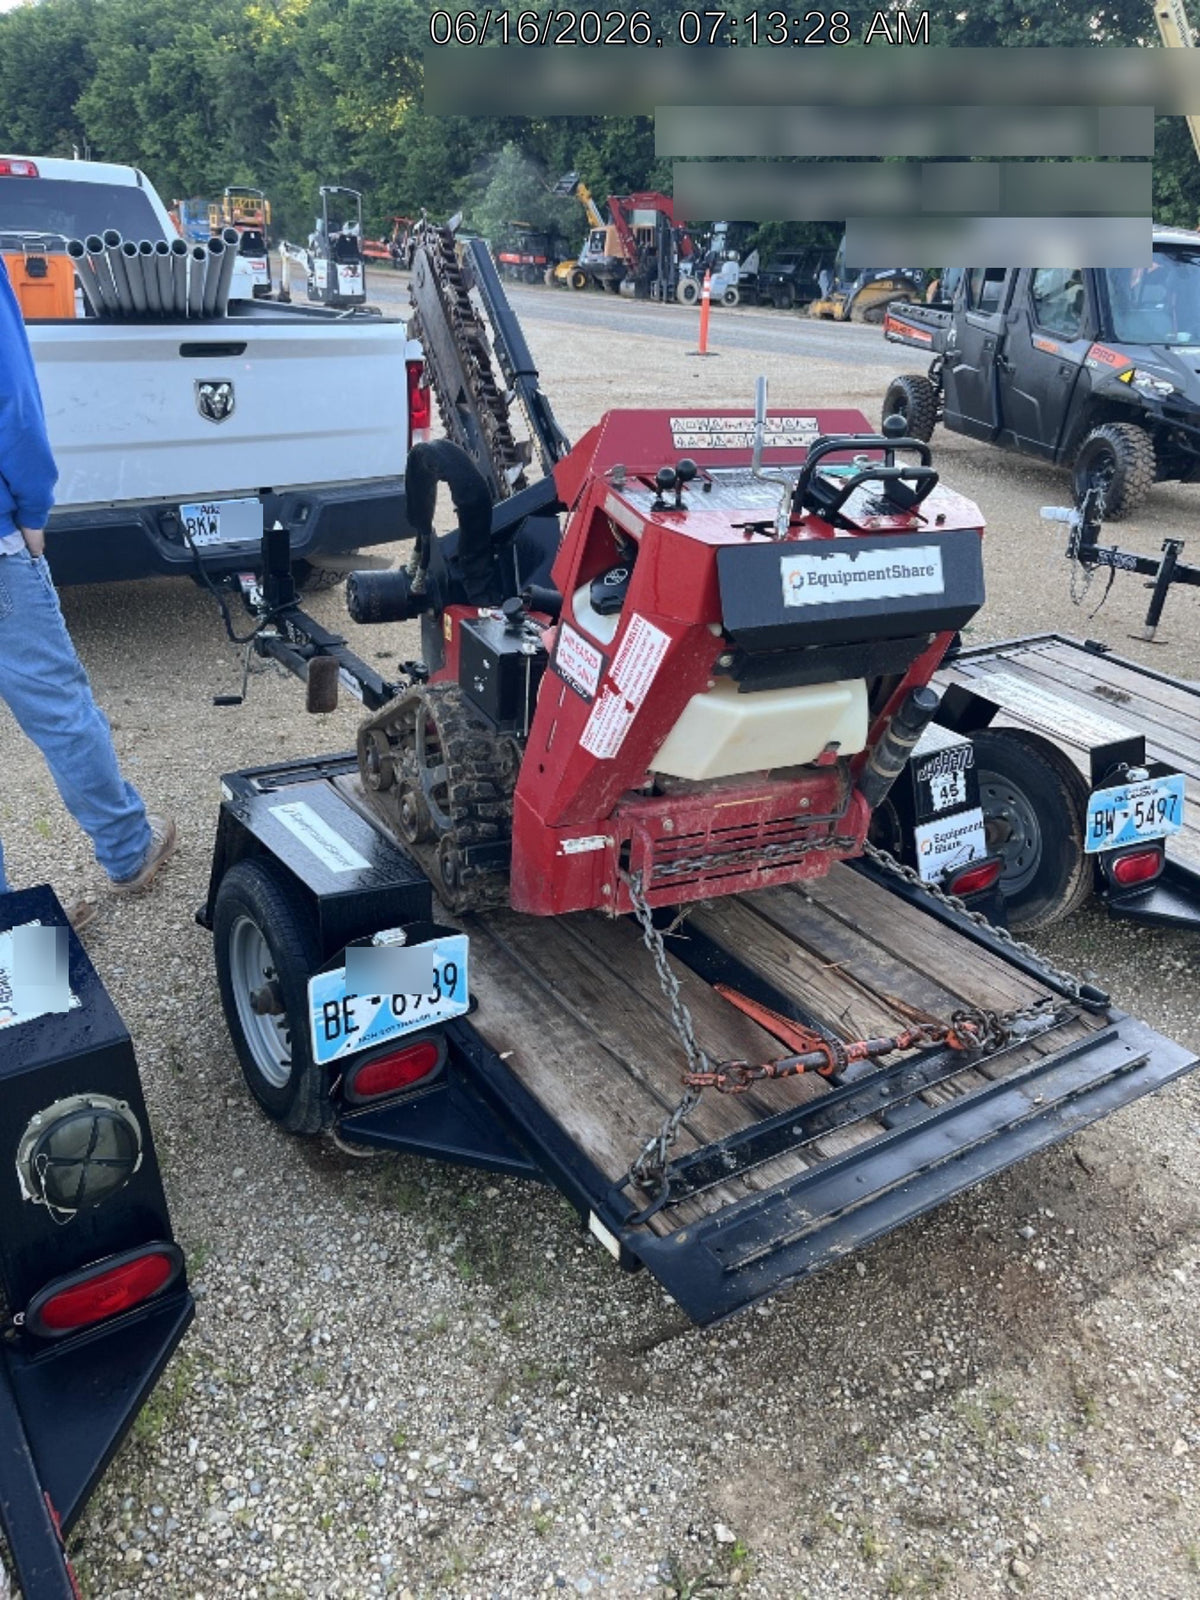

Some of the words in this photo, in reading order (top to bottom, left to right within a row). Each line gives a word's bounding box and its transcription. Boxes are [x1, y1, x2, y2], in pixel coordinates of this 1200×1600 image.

[1091, 347, 1116, 363] PRO
[807, 565, 935, 587] EquipmentShare
[940, 784, 959, 798] 45
[1135, 794, 1178, 829] 5497
[323, 994, 360, 1041] BE
